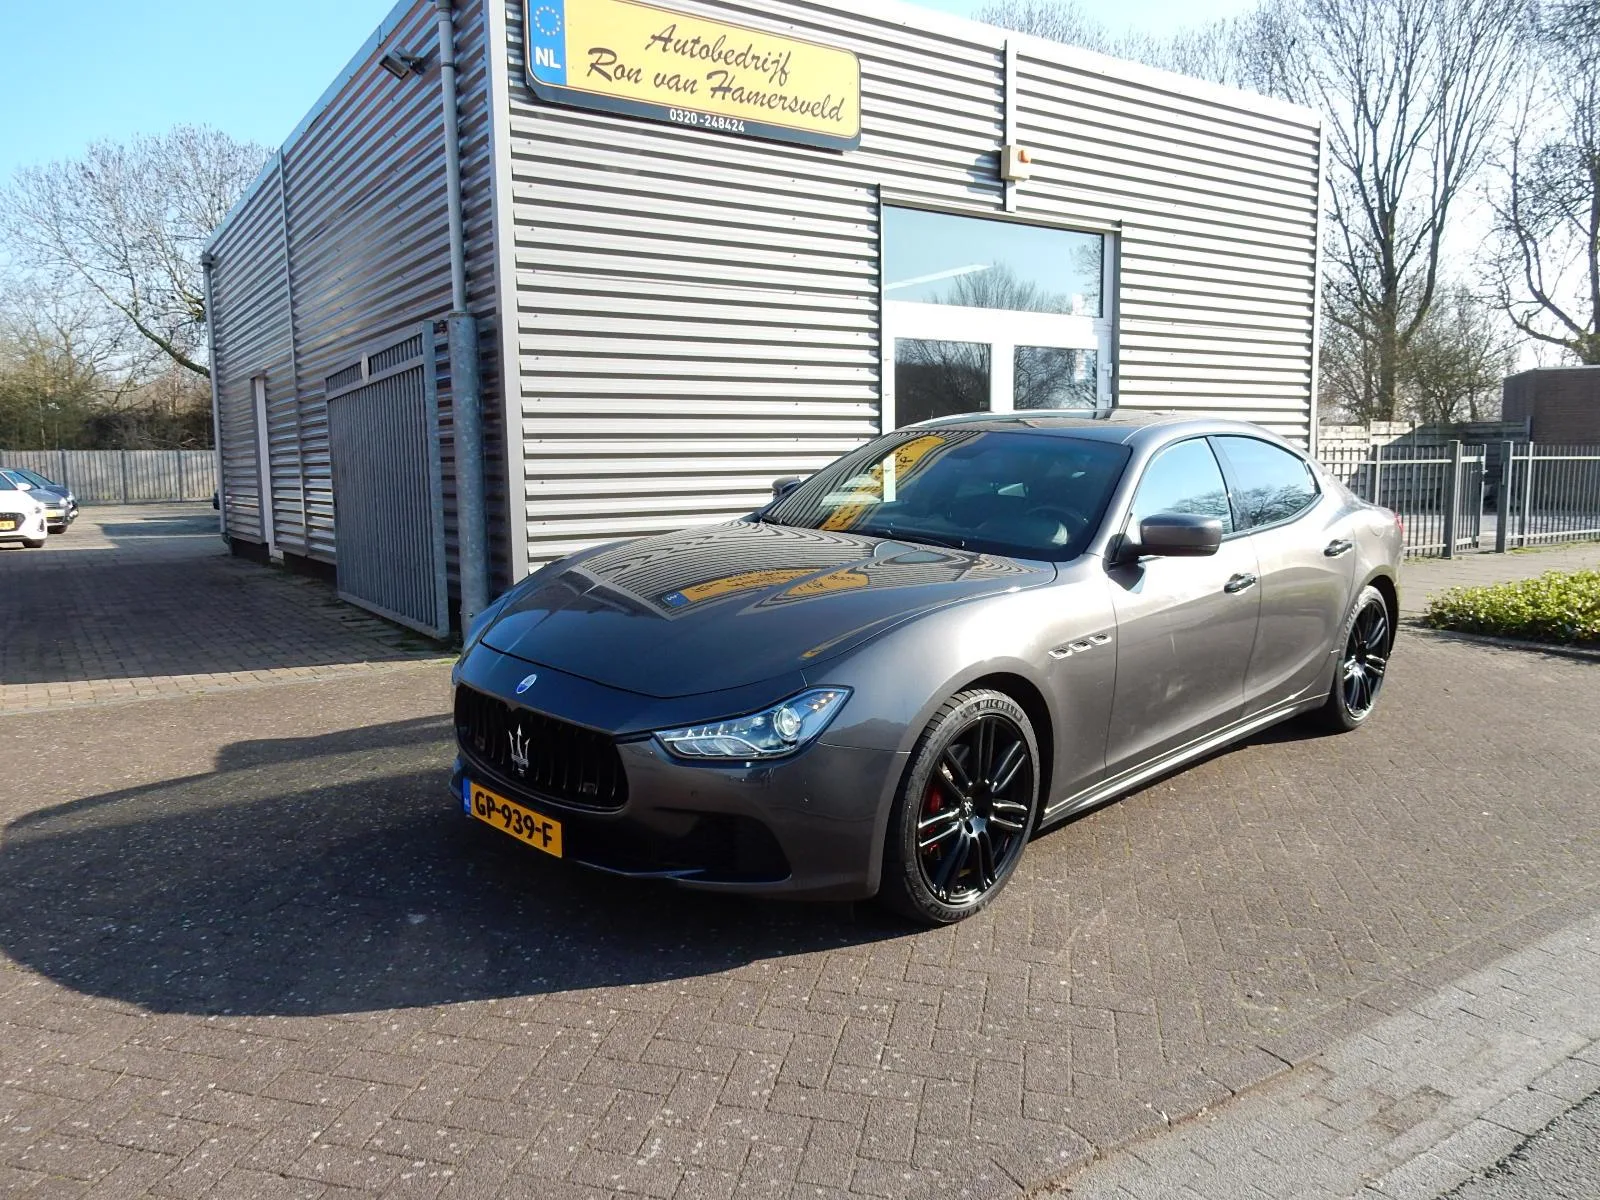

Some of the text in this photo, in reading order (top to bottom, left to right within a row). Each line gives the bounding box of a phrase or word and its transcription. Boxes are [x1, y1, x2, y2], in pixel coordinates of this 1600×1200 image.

[535, 46, 561, 70] NL
[587, 47, 846, 122] Ron van Hamersveld
[645, 24, 793, 87] Autobedrijf
[474, 790, 553, 848] GP-939-F
